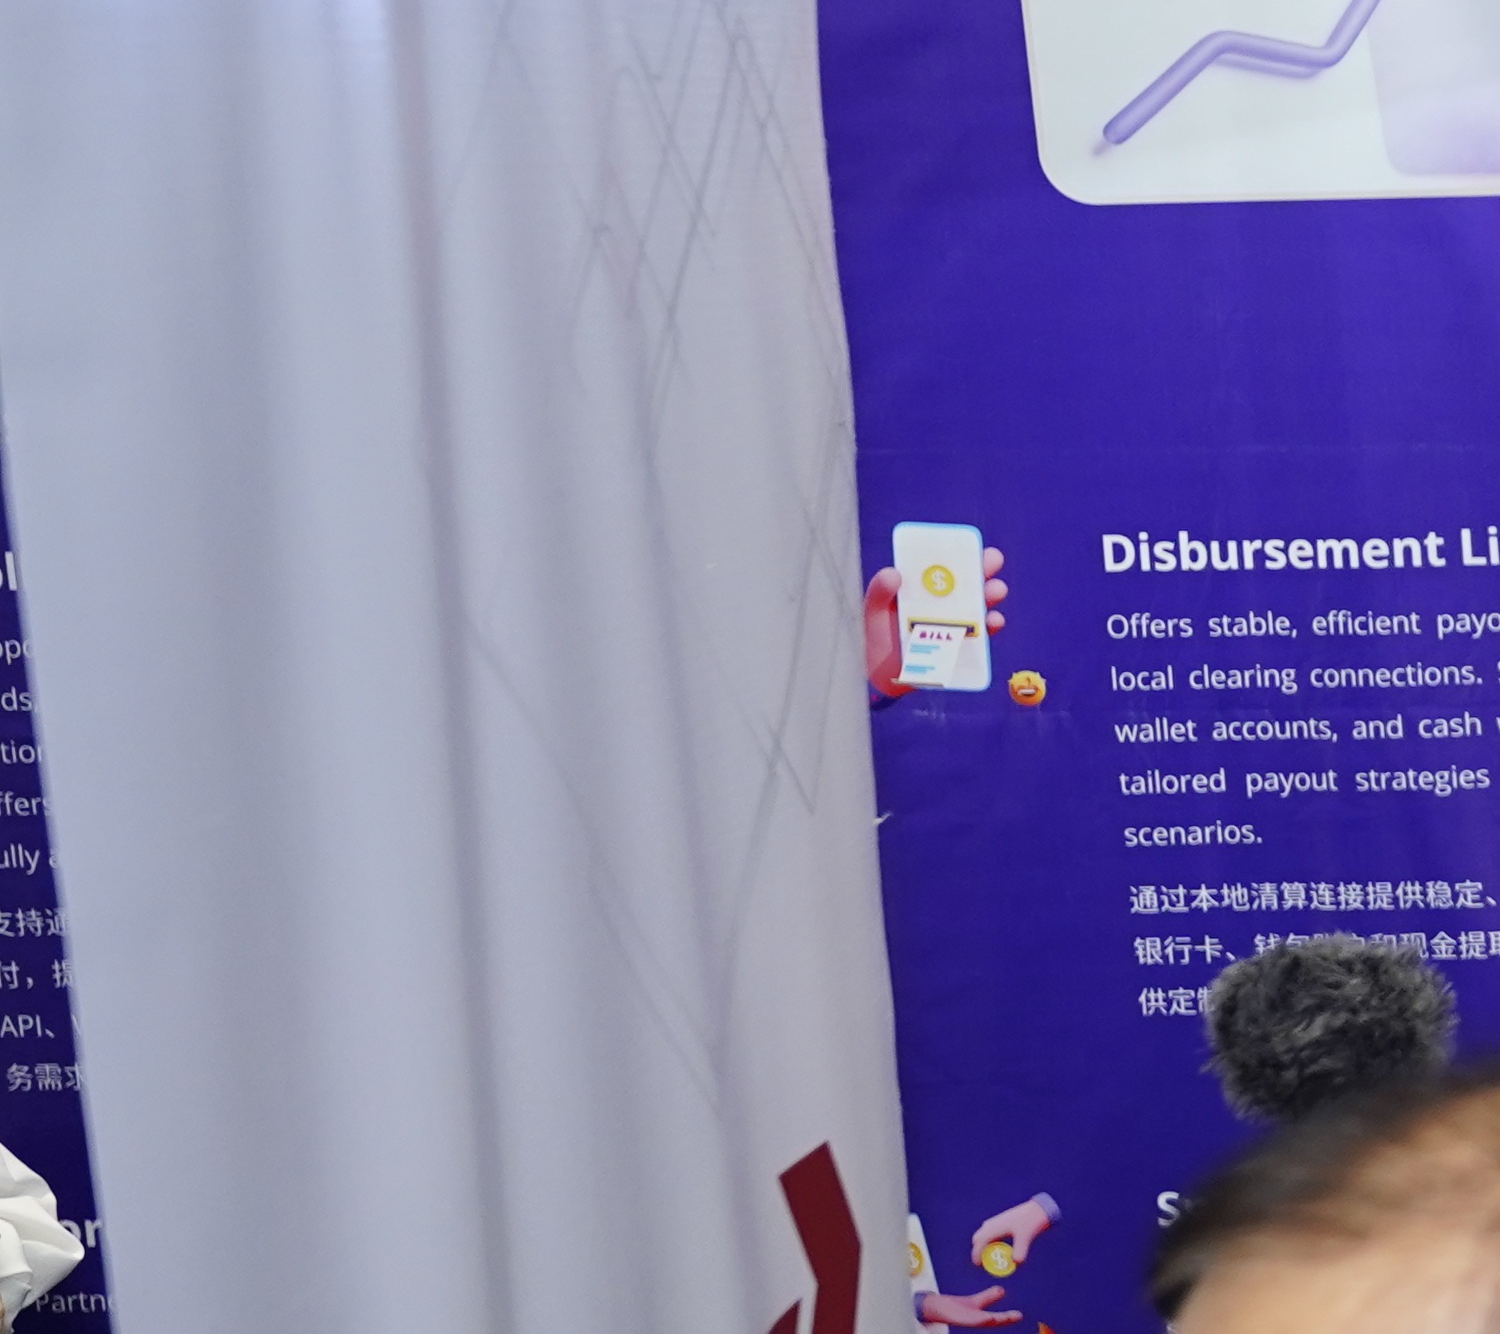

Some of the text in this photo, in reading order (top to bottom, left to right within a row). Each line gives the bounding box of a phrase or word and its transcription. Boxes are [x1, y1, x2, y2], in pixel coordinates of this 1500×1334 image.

[1102, 530, 1446, 572] Disbursement
[1106, 612, 1194, 639] Offers
[1209, 610, 1298, 638] stable,
[1312, 610, 1422, 636] efficient
[1111, 665, 1174, 691] local
[1189, 663, 1298, 695] clearing
[1310, 662, 1483, 689] connections.
[1114, 717, 1197, 743] wallet
[1212, 717, 1339, 743] accounts,
[1352, 714, 1403, 740] and
[1418, 711, 1482, 739] cash
[1120, 768, 1226, 796] tailored
[1246, 768, 1338, 798] payout
[1355, 765, 1490, 798] strategies
[1124, 820, 1263, 848] scenarios.
